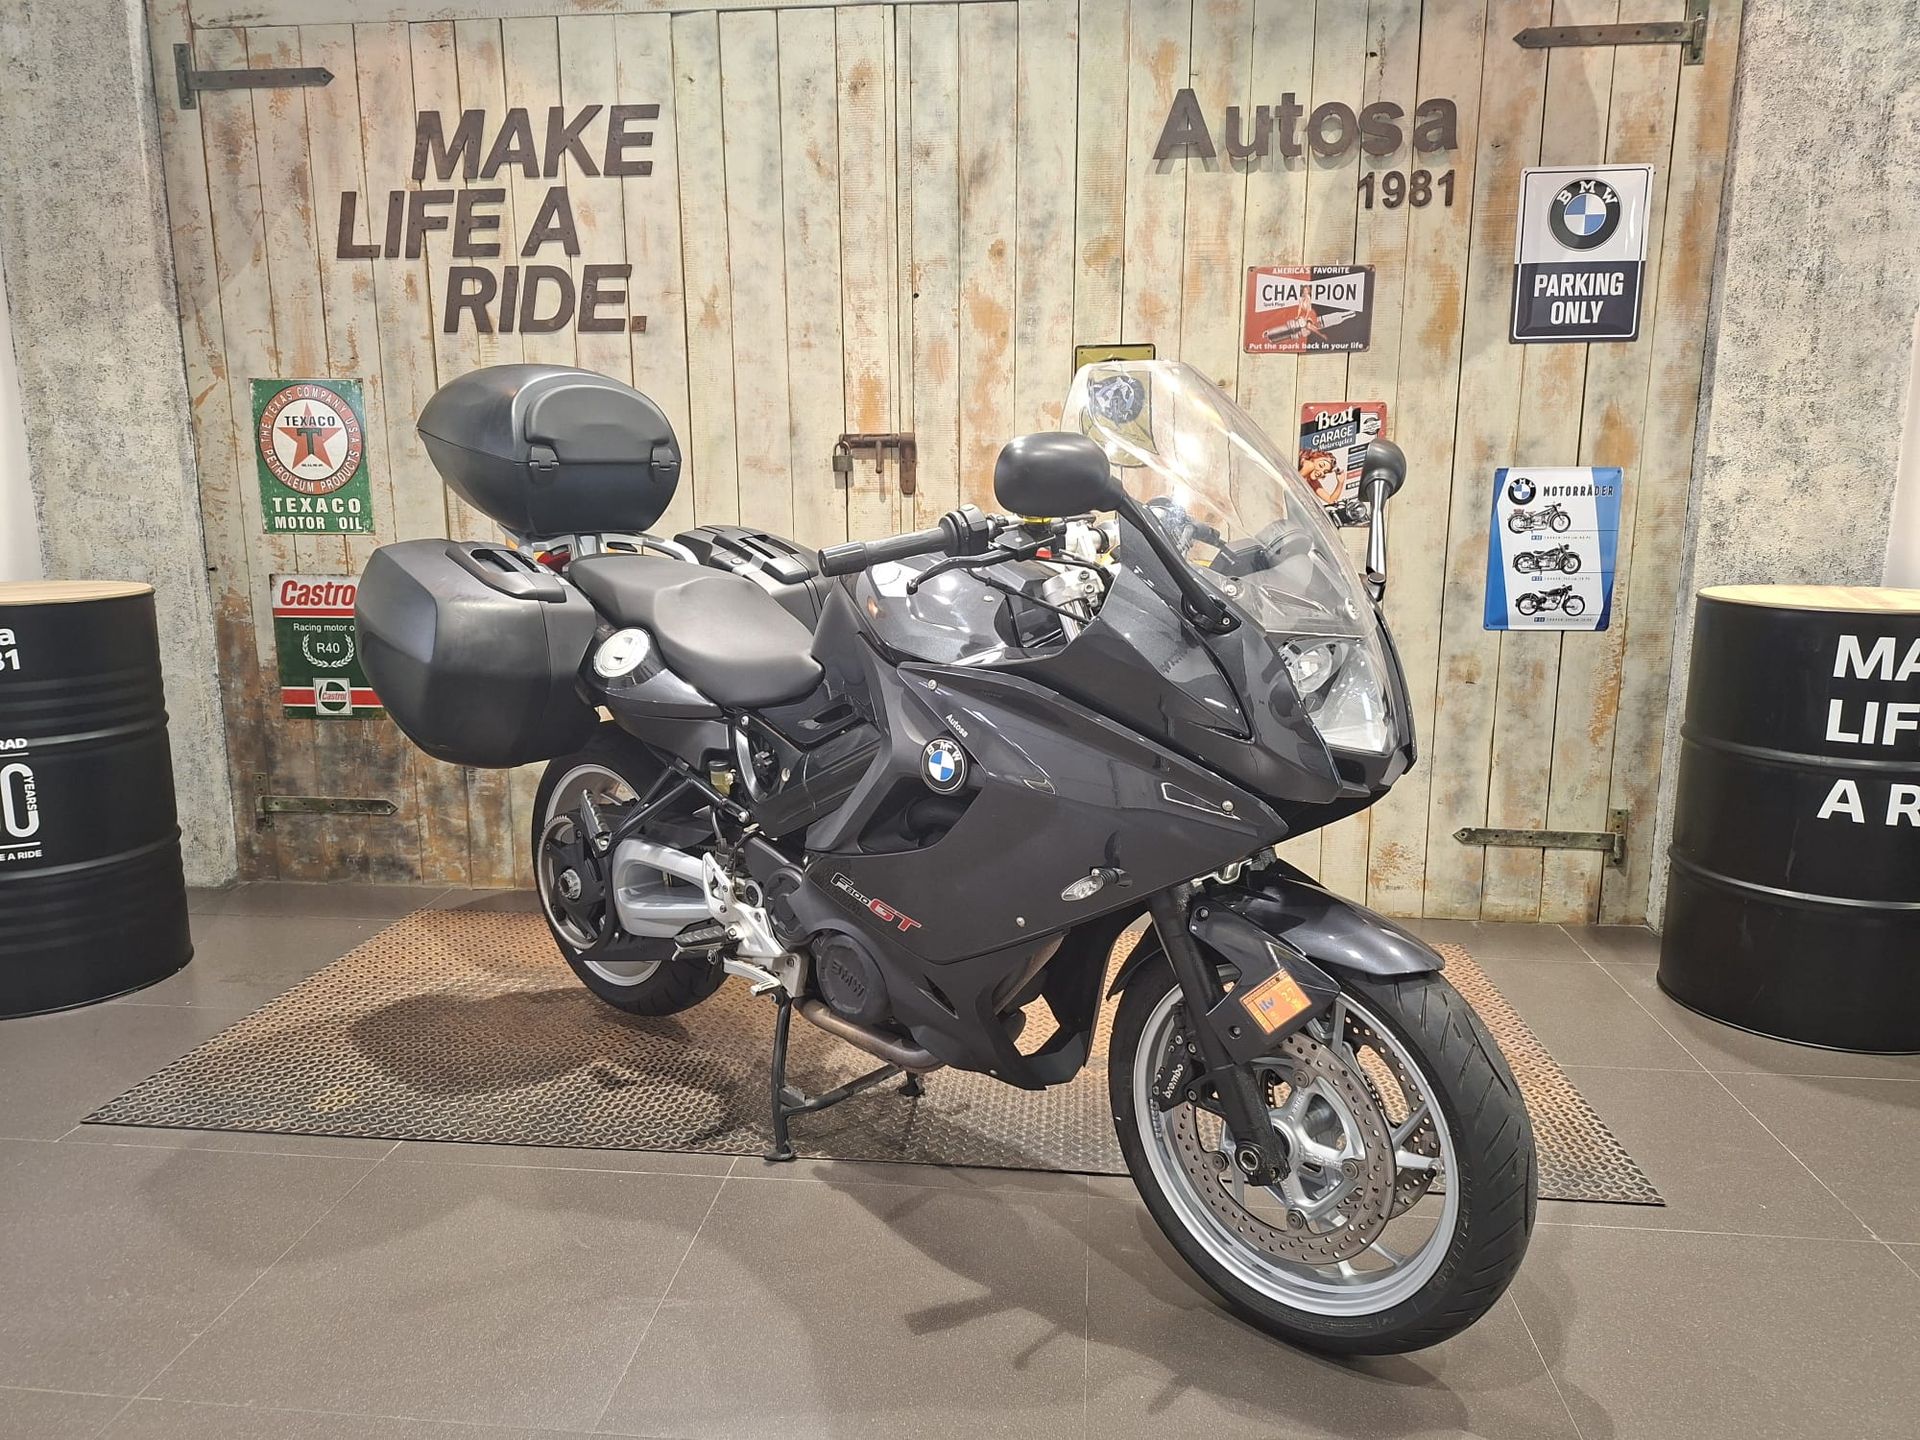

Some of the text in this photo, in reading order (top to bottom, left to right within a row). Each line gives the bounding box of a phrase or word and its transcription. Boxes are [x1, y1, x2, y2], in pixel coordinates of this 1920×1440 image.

[1152, 88, 1458, 160] Autosa
[411, 104, 660, 180] MAKE
[1357, 169, 1455, 209] 1981
[1556, 180, 1618, 206] BMW
[336, 186, 581, 259] LIFE A
[1313, 266, 1350, 274] FAVORITE
[1533, 272, 1625, 298] PARKING
[443, 264, 647, 333] RIDE.
[1550, 301, 1604, 325] ONLY
[1249, 342, 1262, 350] Put
[1279, 342, 1300, 350] spark
[264, 388, 293, 419] TEXAS
[296, 386, 347, 413] COMPANY
[284, 415, 336, 426] TEXACO
[1315, 405, 1354, 430] Best
[260, 422, 271, 442] THE
[1312, 424, 1354, 446] GARAGE
[264, 449, 360, 492] PETROLEUM PRODUCTS
[272, 497, 361, 513] TEXACO
[274, 516, 363, 530] MOTOR OIL
[293, 623, 322, 633] Racing
[324, 623, 348, 632] motor
[316, 642, 340, 654] R40
[321, 692, 348, 701] Castrol
[945, 714, 969, 738] Autosa
[926, 741, 962, 761] BMW
[24, 776, 38, 811] YEARS
[1816, 778, 1920, 828] A R
[7, 852, 16, 861] A
[17, 849, 42, 860] RIDE
[1162, 1063, 1184, 1099] brembo
